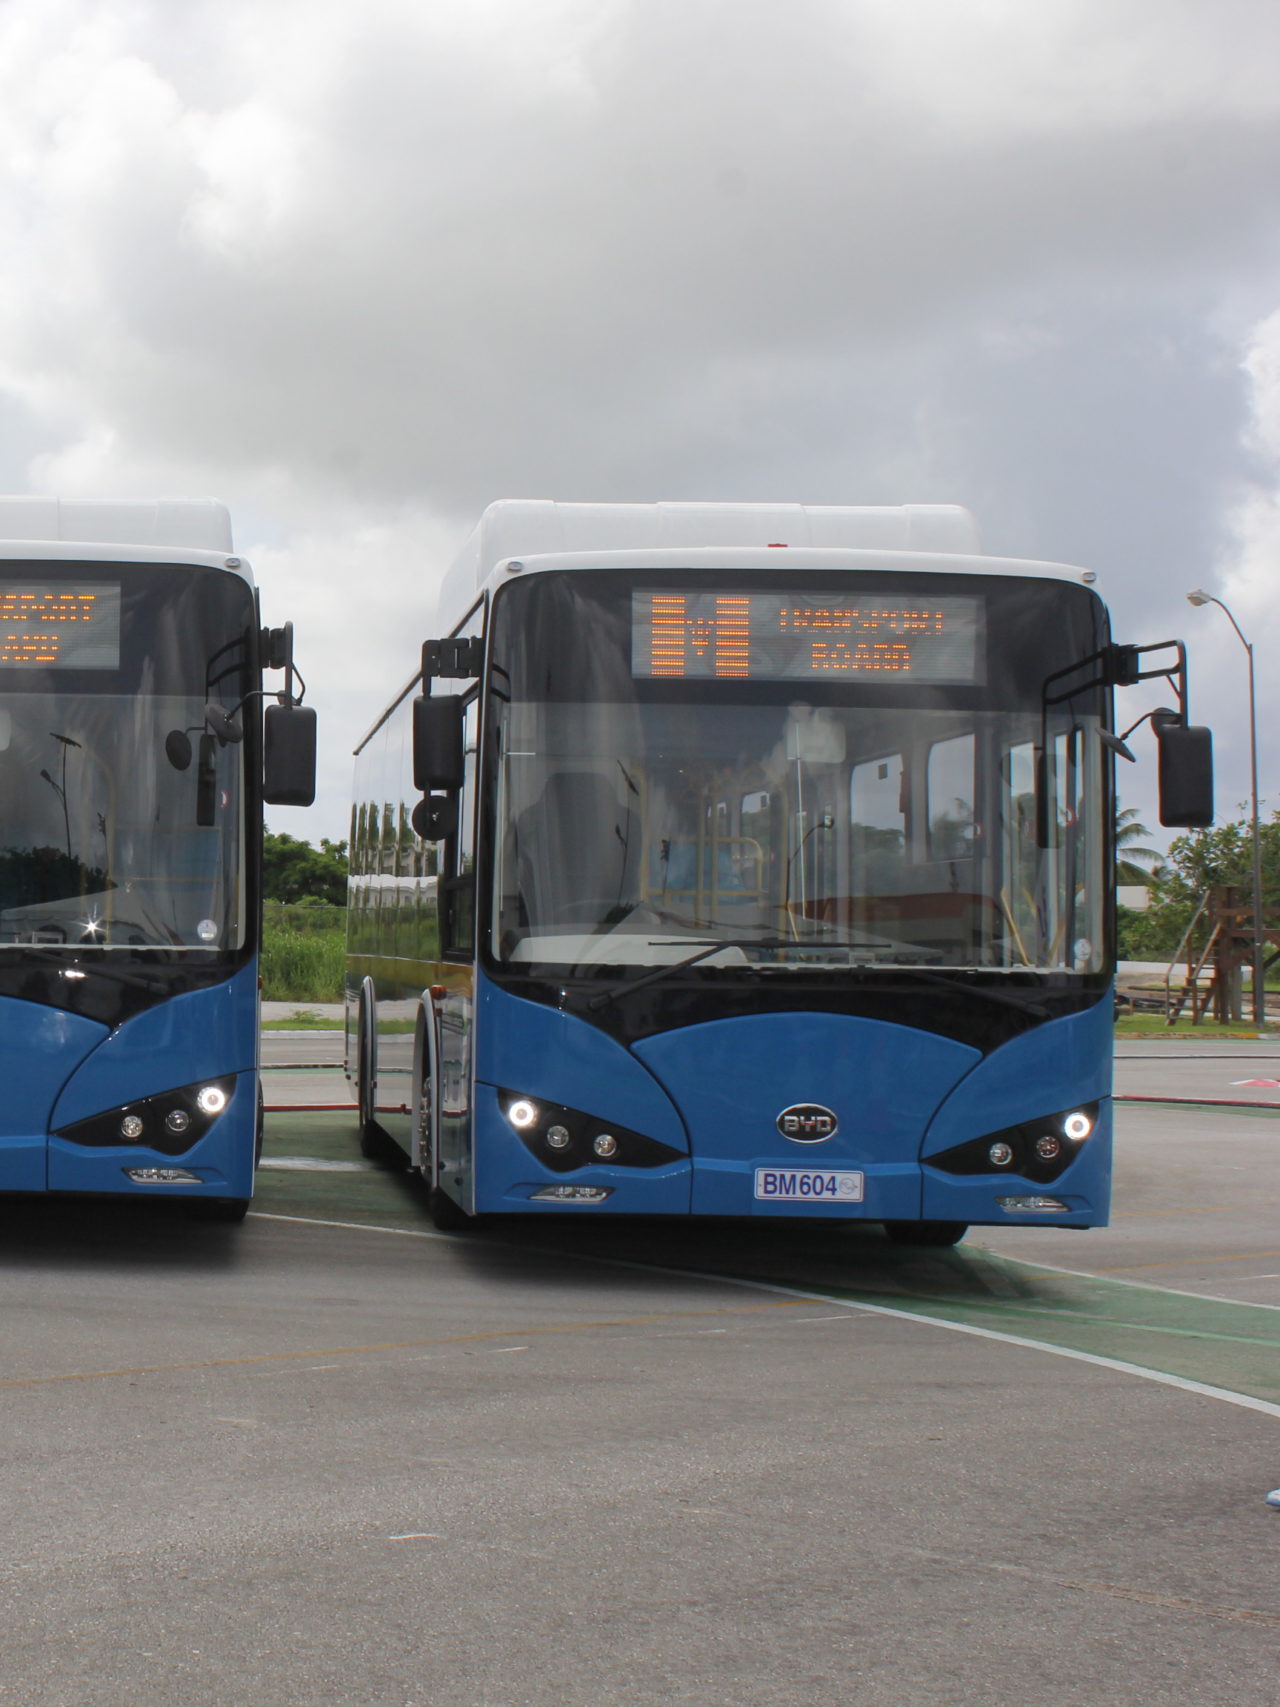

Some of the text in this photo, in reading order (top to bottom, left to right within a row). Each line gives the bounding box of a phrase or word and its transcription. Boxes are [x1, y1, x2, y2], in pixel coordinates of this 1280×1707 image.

[779, 608, 943, 637] TRANSPORT
[810, 642, 911, 672] BOARD
[783, 1115, 833, 1132] BYD
